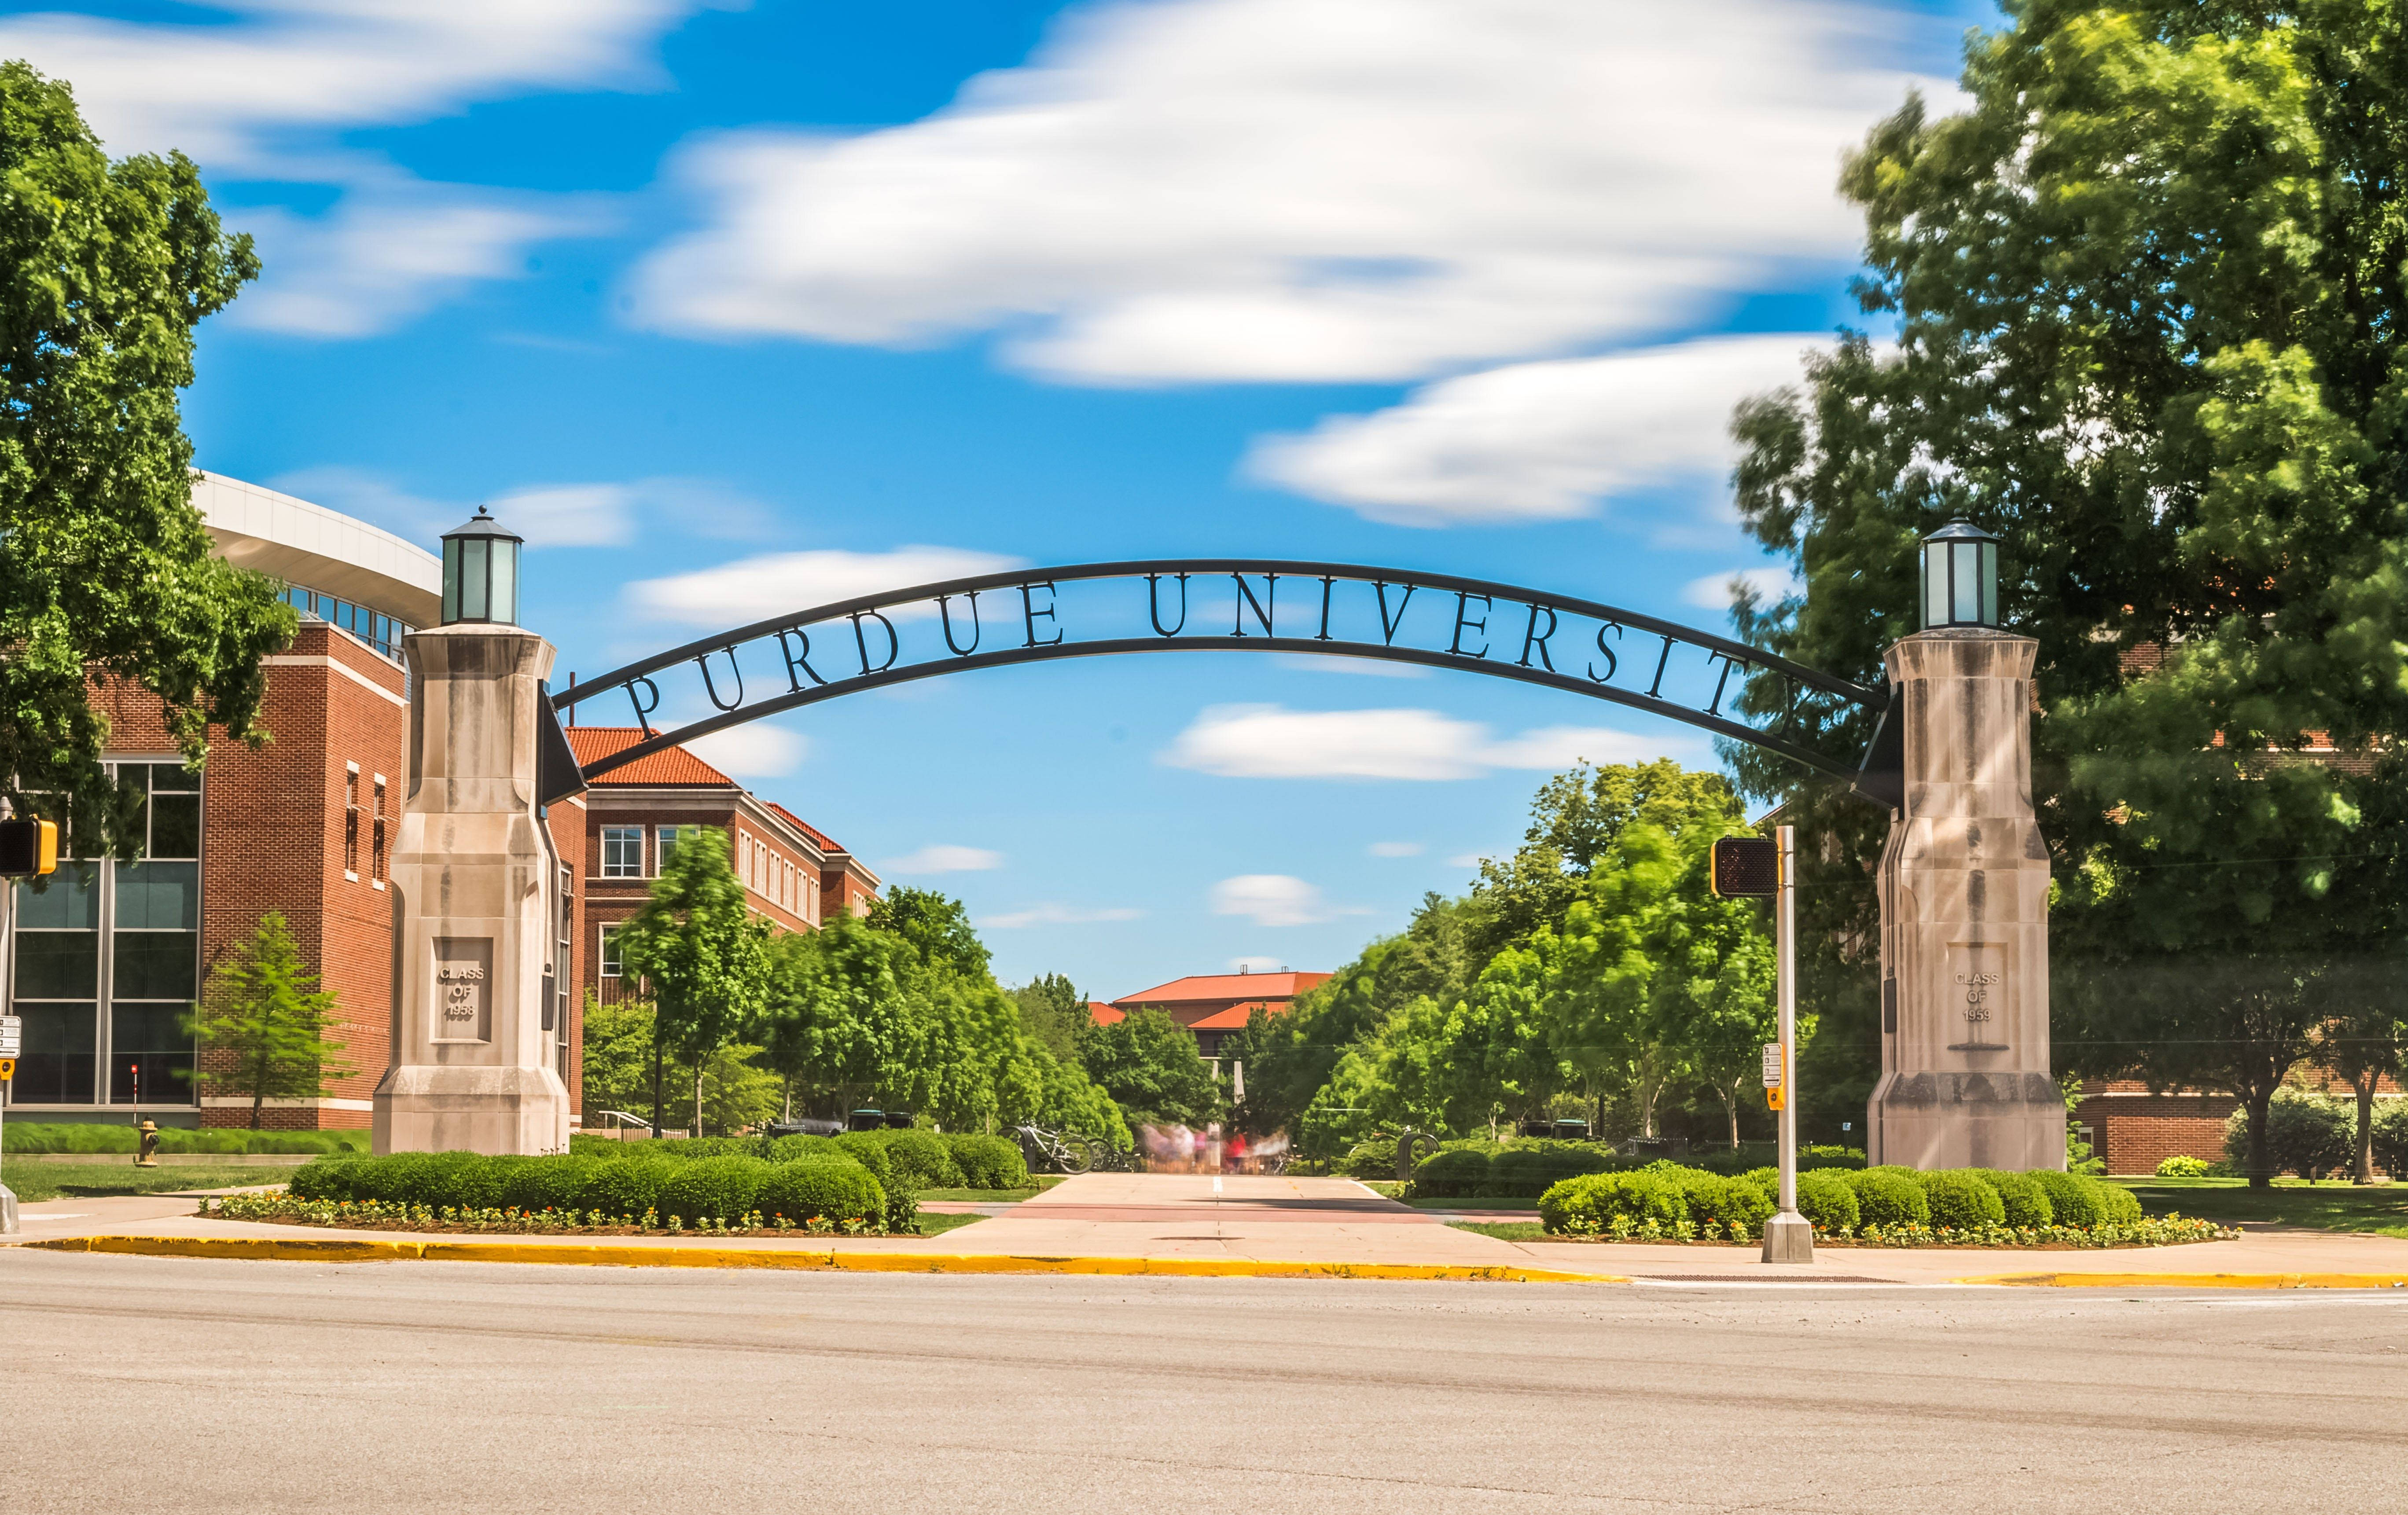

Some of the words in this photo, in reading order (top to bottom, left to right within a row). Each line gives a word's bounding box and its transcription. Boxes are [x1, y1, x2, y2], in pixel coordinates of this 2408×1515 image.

[621, 582, 1063, 741] PURDUE
[1143, 575, 1818, 738] UNIVERSITY
[440, 968, 484, 979] CLASS
[1955, 973, 1999, 984] CLASS
[452, 986, 472, 998] OF
[1968, 991, 1986, 1002] OF
[449, 1005, 475, 1015] 1958
[1963, 1009, 1991, 1021] 1959
